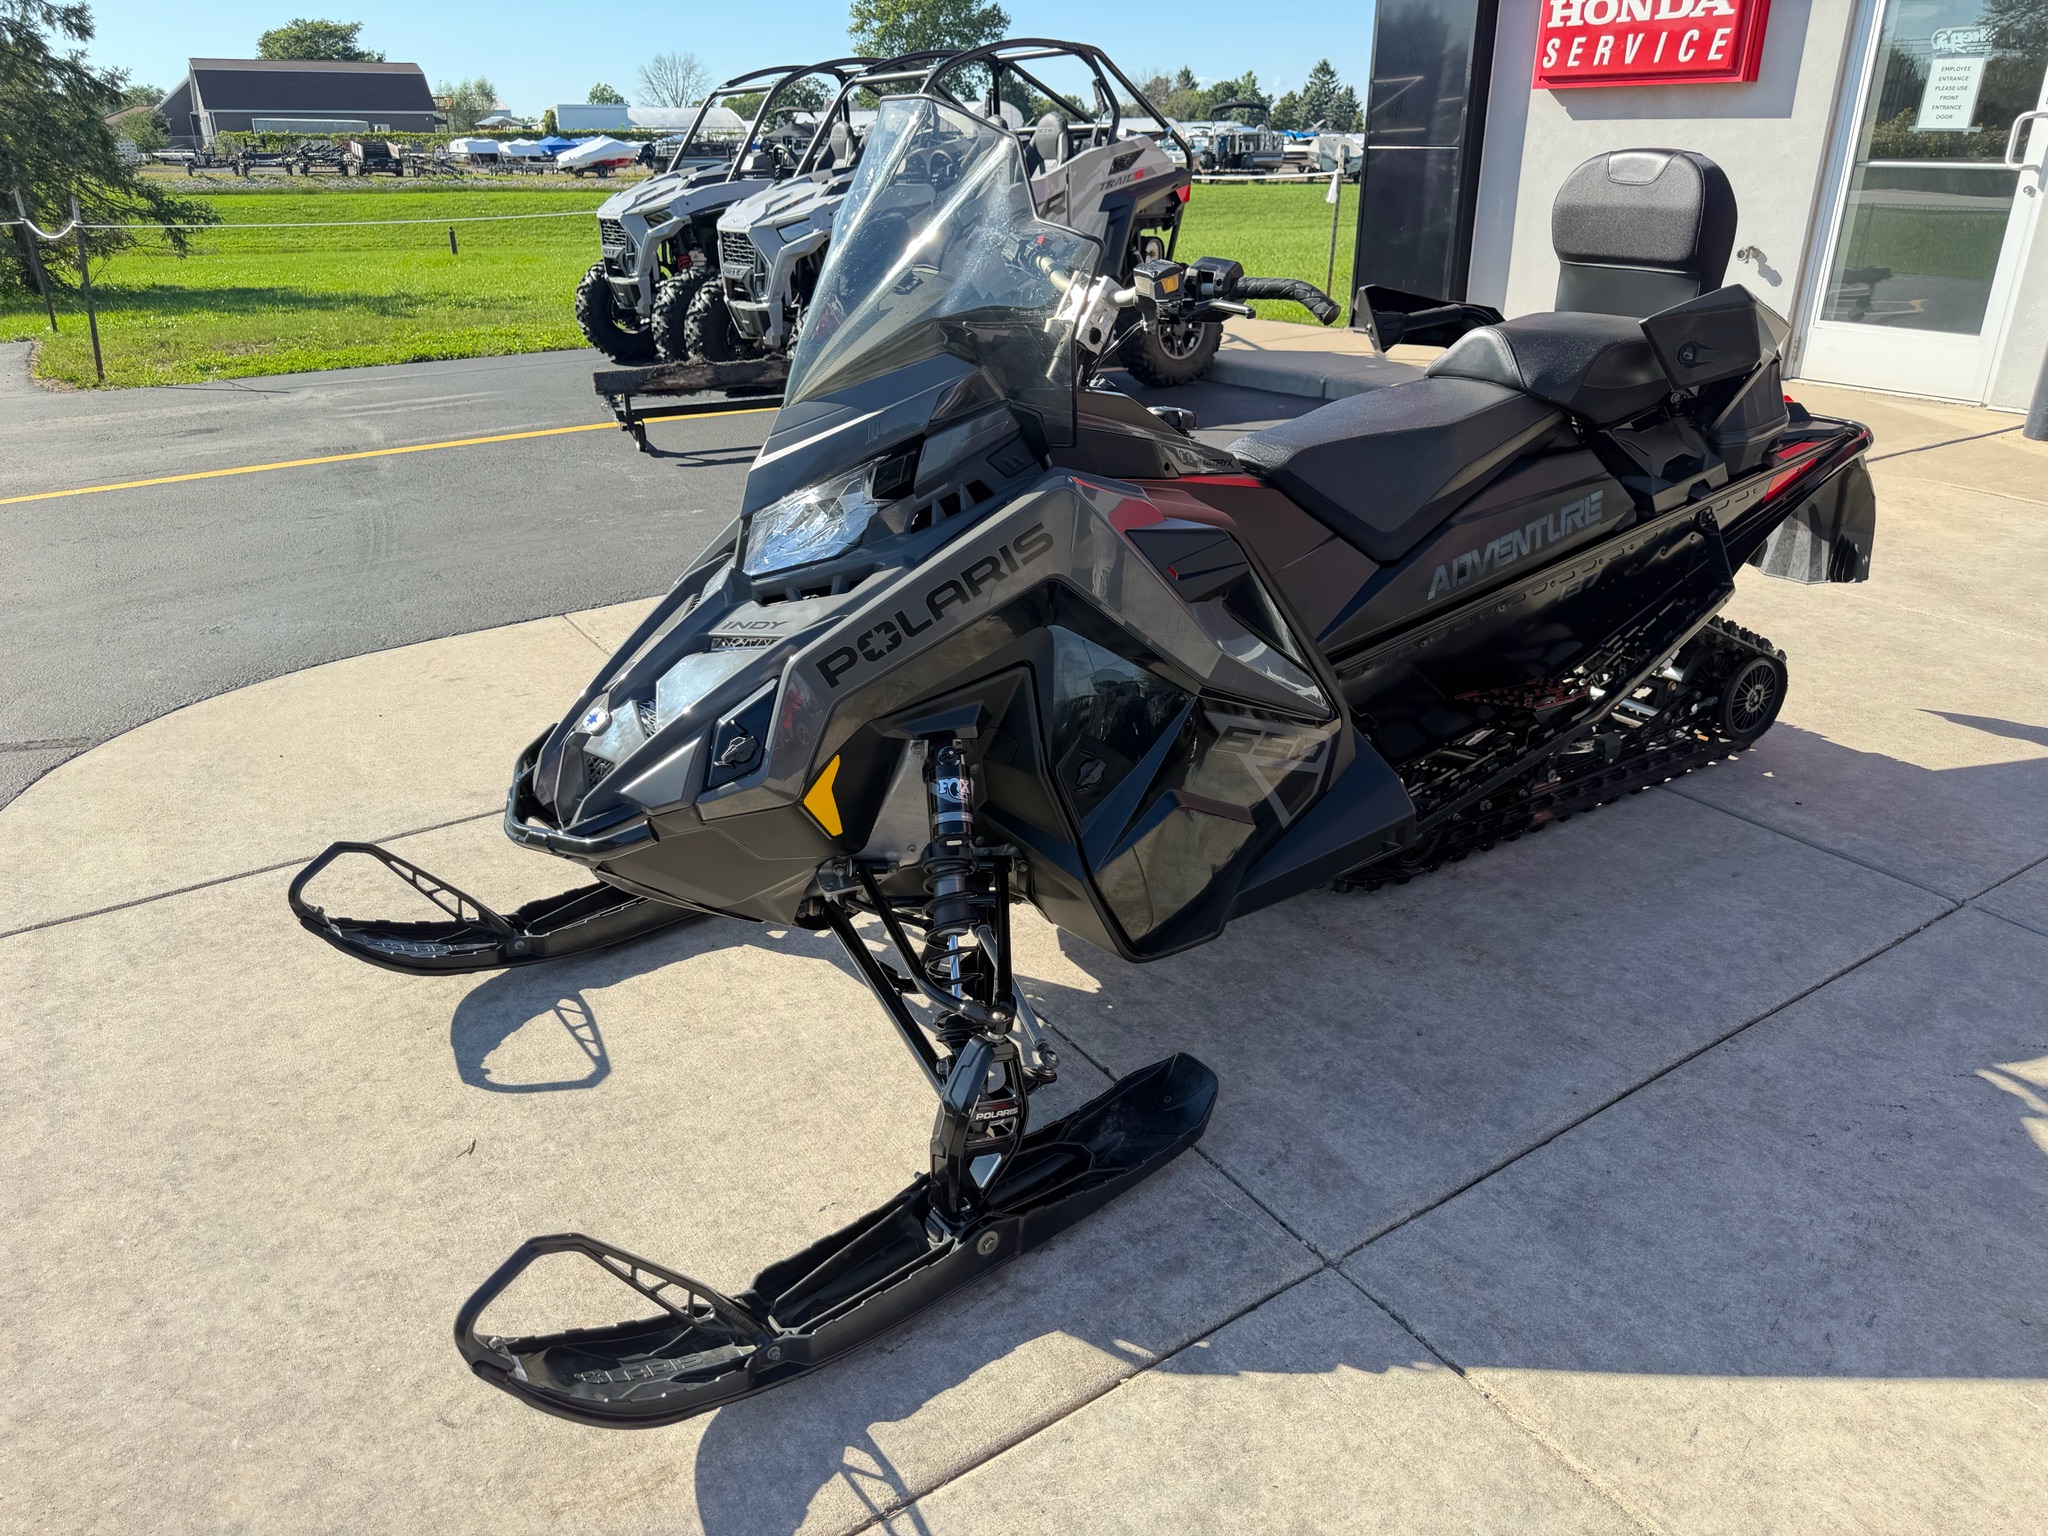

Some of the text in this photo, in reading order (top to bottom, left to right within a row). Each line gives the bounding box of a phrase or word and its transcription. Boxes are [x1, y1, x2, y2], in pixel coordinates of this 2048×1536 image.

[1547, 0, 1735, 28] HONDA
[1542, 28, 1732, 69] SERVICE
[1100, 173, 1133, 191] TRAIL
[1428, 490, 1604, 600] ADVENTURE
[816, 522, 1054, 689] POLARIS
[722, 621, 789, 630] INDY
[1211, 725, 1328, 763] 650
[939, 777, 970, 799] FOX
[975, 1107, 1019, 1120] POLARIS
